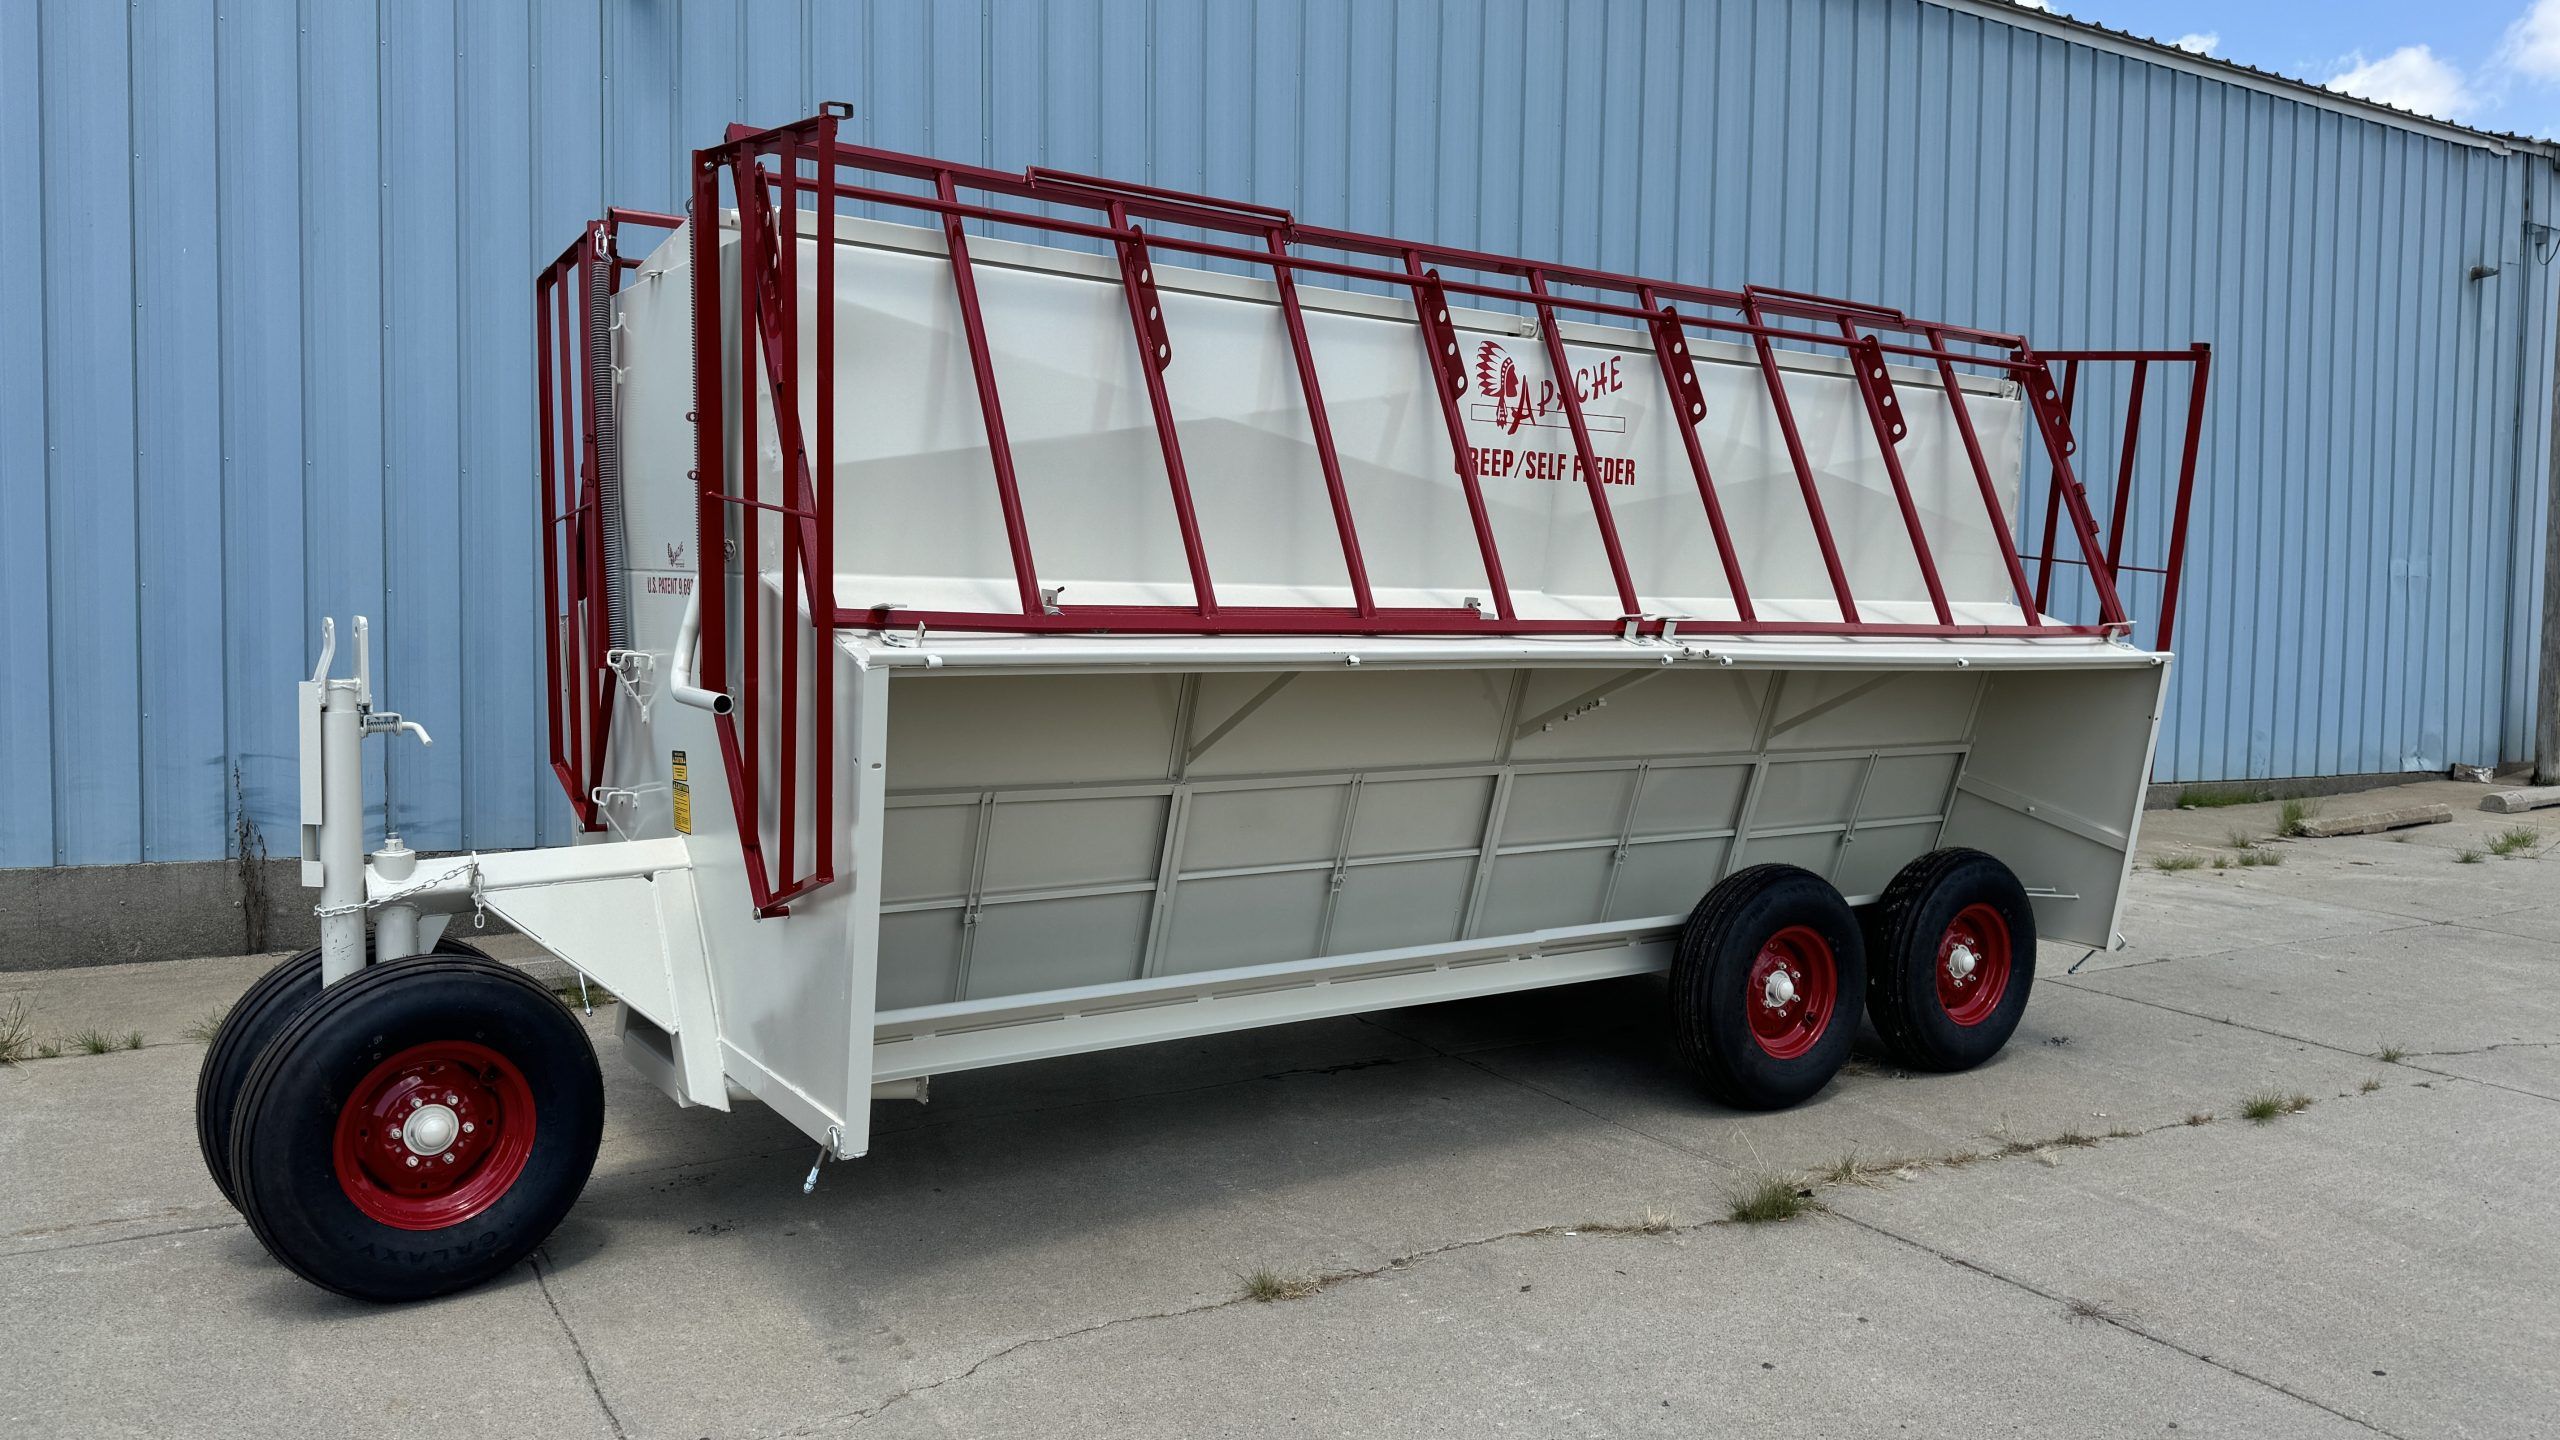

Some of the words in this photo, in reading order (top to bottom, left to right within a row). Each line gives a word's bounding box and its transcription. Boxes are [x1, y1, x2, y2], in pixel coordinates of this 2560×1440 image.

[1455, 447, 1567, 481] REEP/SELF
[1573, 455, 1635, 485] FEDER
[647, 576, 657, 594] U.S.
[659, 577, 677, 595] PATENT
